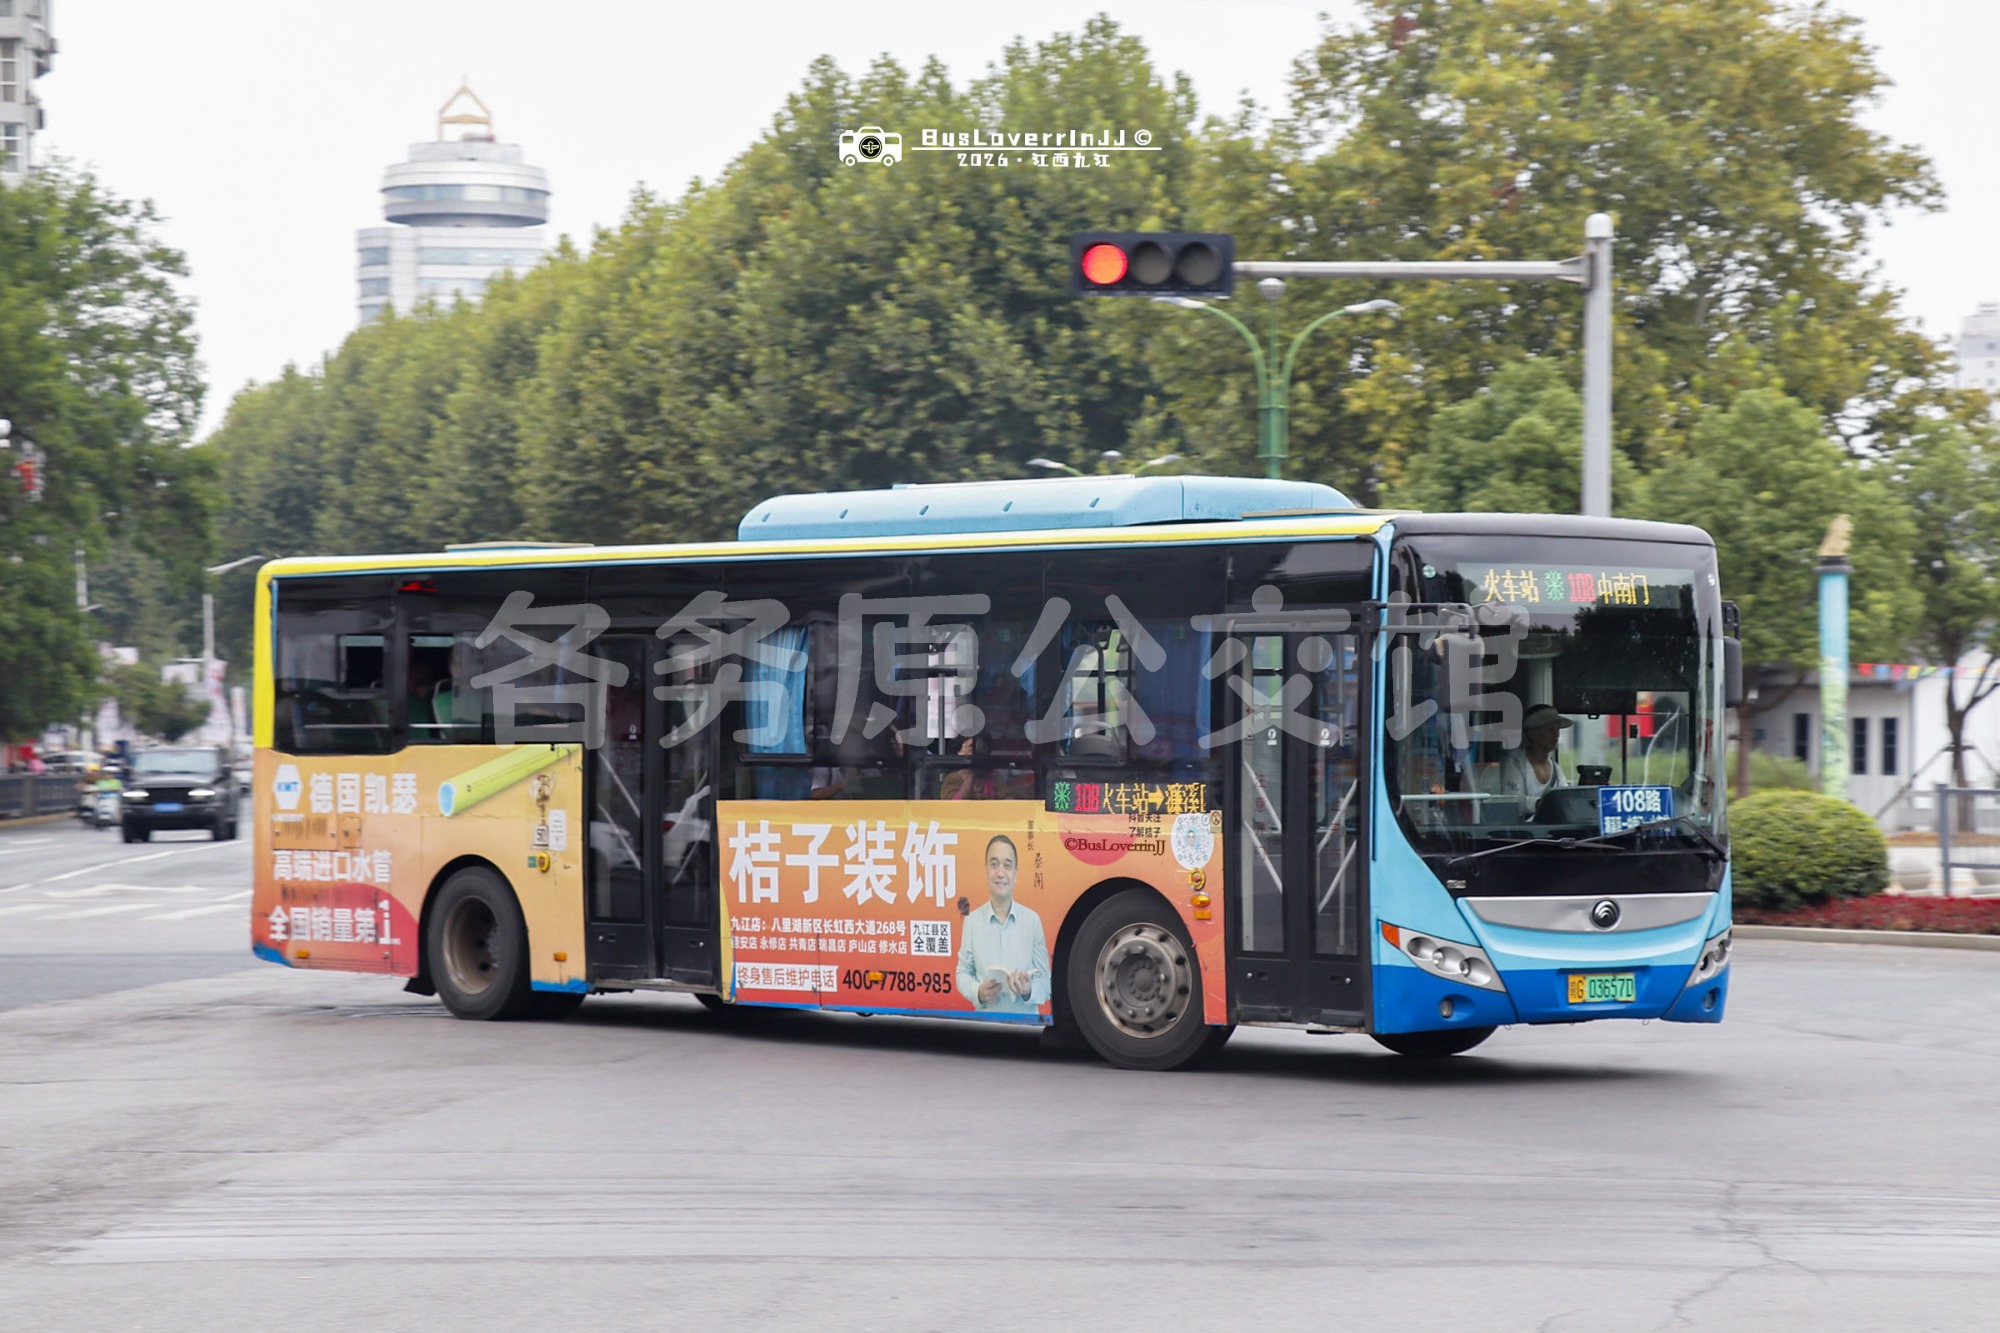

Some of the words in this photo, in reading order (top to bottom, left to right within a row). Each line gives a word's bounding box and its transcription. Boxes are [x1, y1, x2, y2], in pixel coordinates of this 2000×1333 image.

[1484, 568, 1540, 603] 火车站
[1567, 573, 1597, 602] 108
[1075, 783, 1100, 812] 108
[1612, 789, 1662, 813] 108路
[273, 849, 393, 883] 高端进口水管
[728, 819, 959, 908] 桔子装饰
[913, 923, 949, 936] 九江县区
[760, 936, 787, 951] 永修店
[789, 937, 817, 952] 共青店
[818, 938, 847, 953] 瑞昌店
[848, 939, 877, 954] 庐山店
[879, 940, 908, 955] 修水店
[913, 936, 950, 954] 全覆盖
[737, 966, 834, 988] 终身售后维护电话
[842, 969, 952, 994] 400-7788-985
